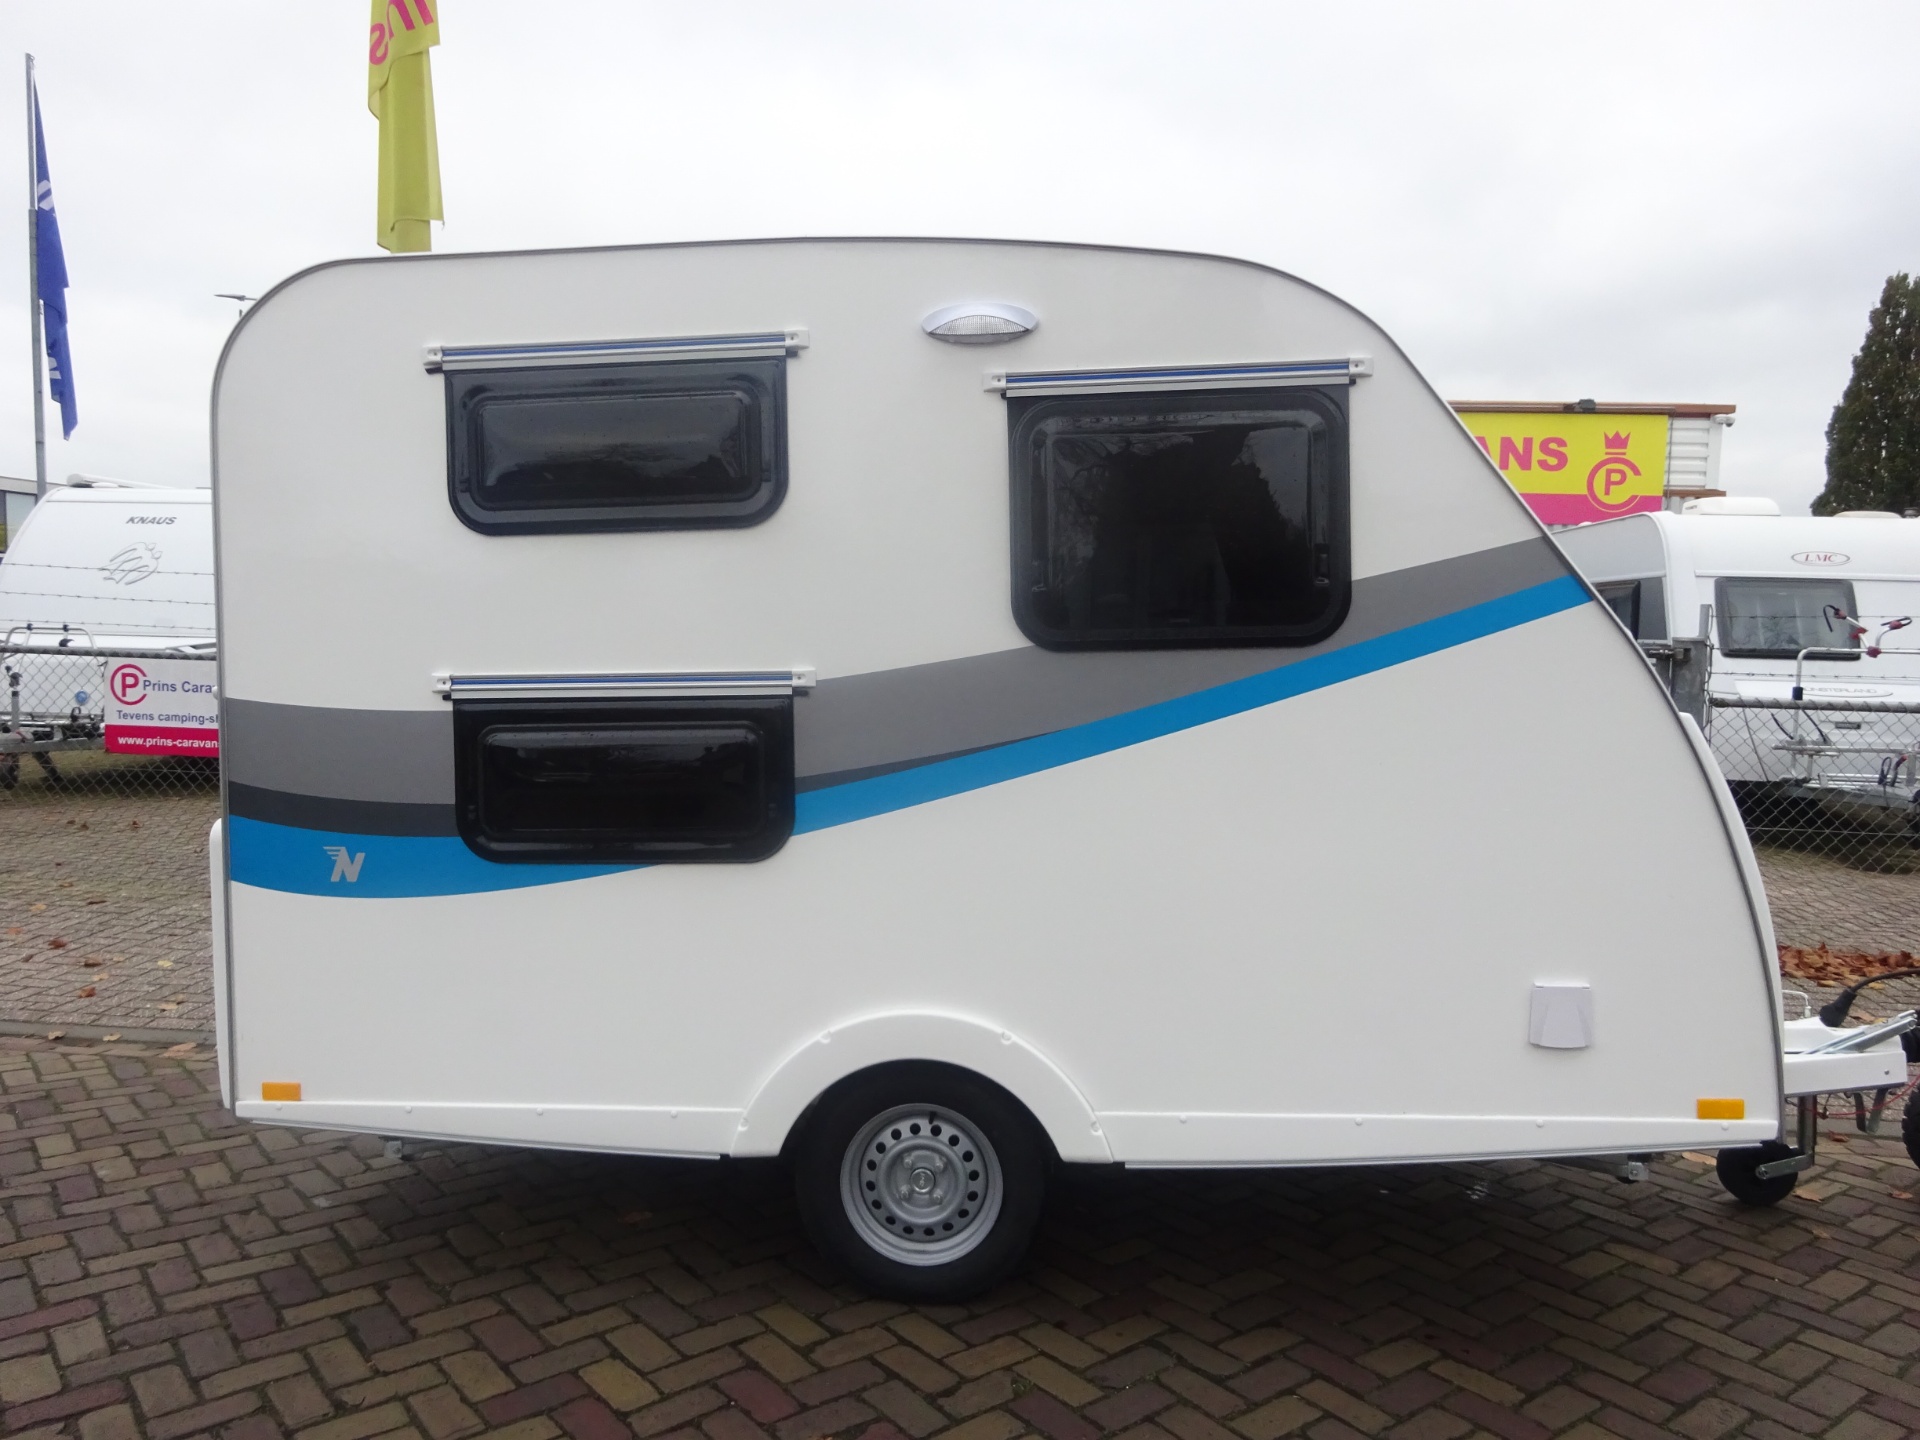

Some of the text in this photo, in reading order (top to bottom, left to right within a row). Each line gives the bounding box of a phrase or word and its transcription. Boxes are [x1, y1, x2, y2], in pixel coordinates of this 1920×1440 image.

[126, 516, 177, 525] KNAUS
[1804, 554, 1838, 562] LMC
[143, 680, 216, 693] Prins Cara
[116, 710, 154, 720] Tevens
[118, 737, 219, 748] www.prins-caravan
